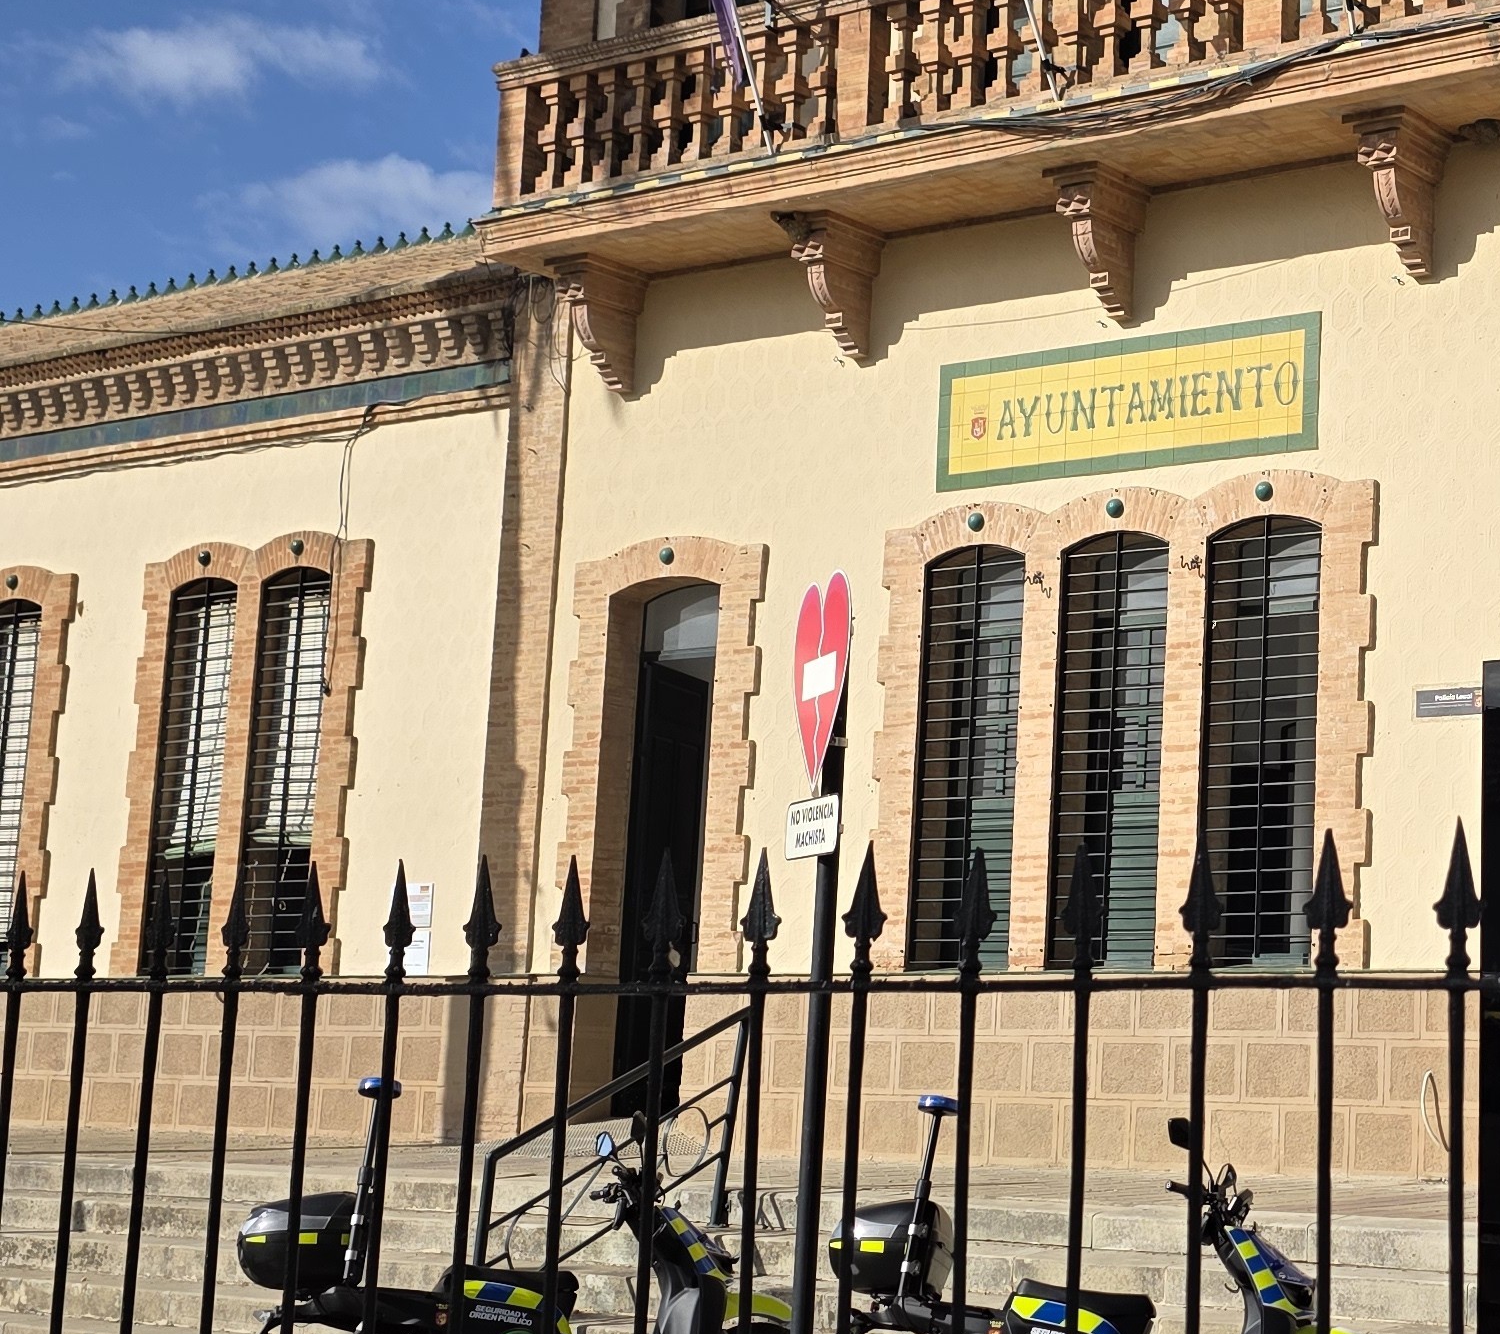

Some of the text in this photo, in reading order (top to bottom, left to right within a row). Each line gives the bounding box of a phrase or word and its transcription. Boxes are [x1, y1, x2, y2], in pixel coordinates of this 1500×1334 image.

[996, 360, 1300, 441] AYUNTAMIENTO
[790, 802, 834, 826] NO VIOLENCIA
[795, 828, 826, 849] MACHISTA
[469, 1311, 497, 1321] ORDEN
[475, 1305, 521, 1318] SEGURIDAD
